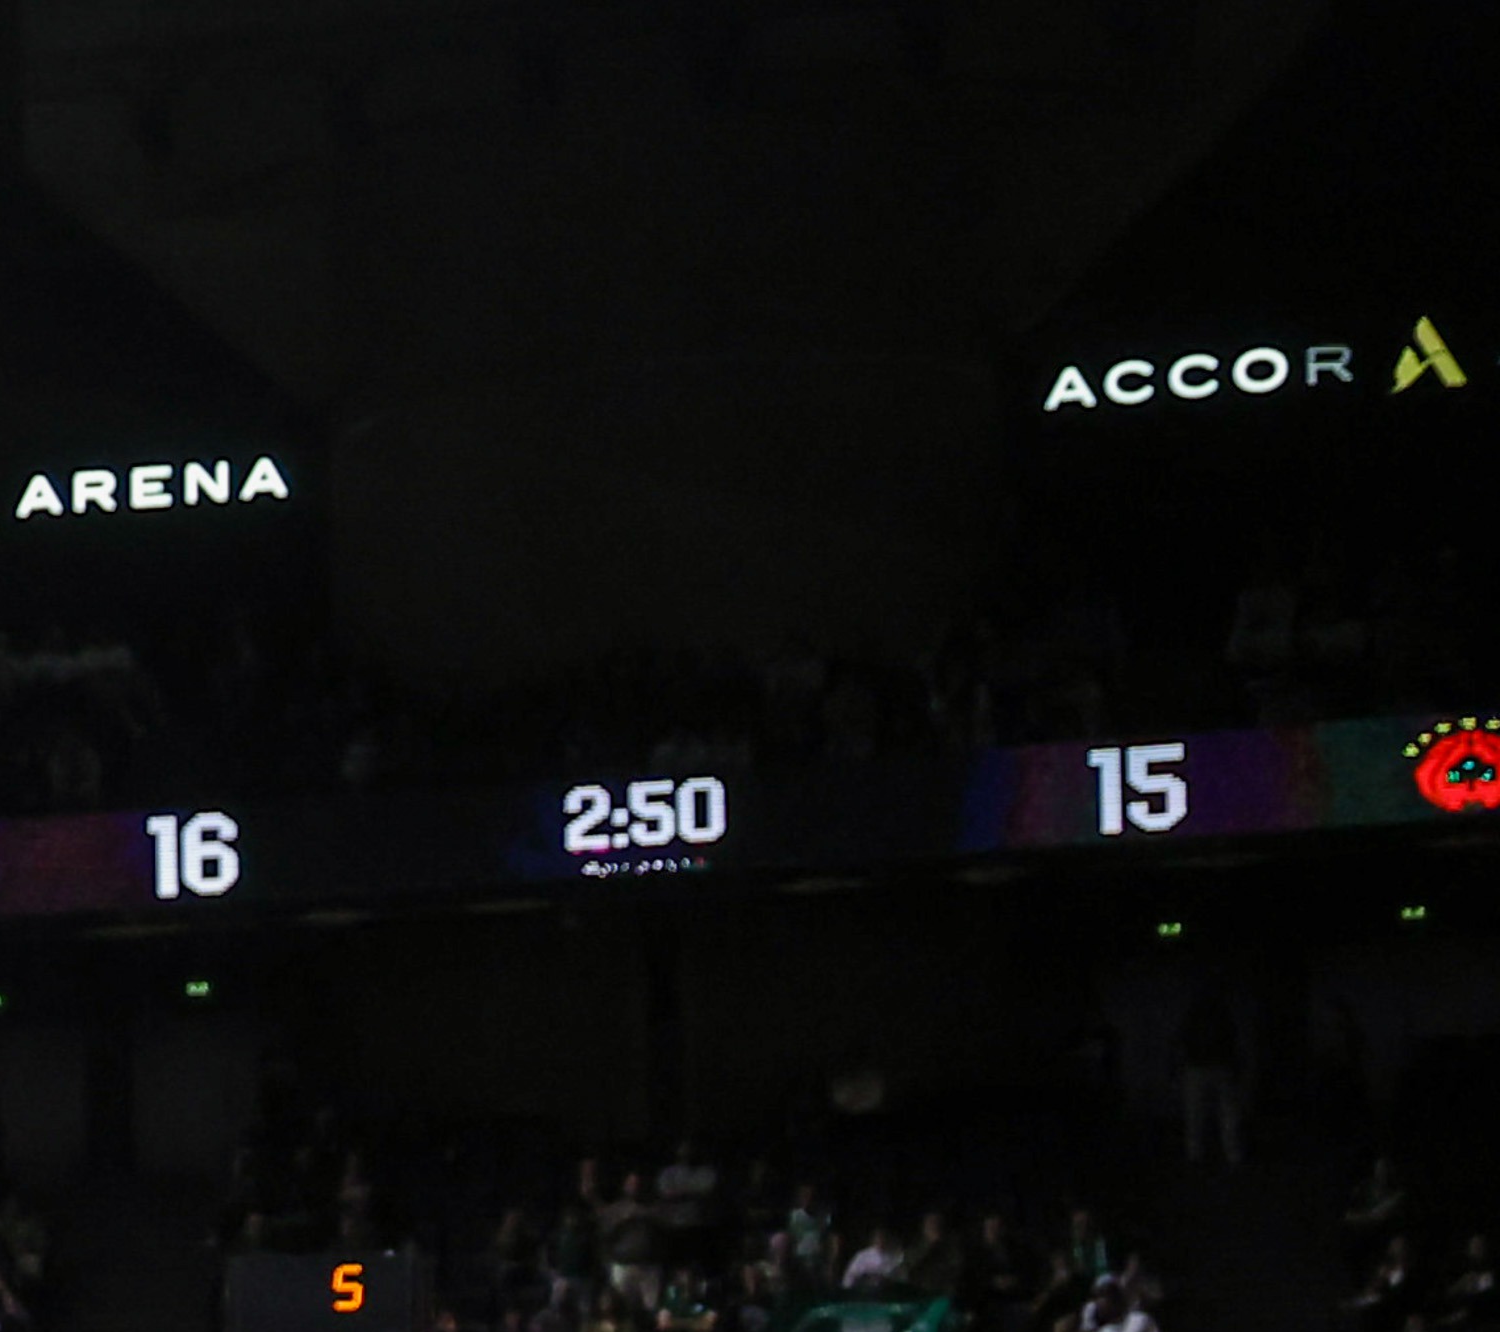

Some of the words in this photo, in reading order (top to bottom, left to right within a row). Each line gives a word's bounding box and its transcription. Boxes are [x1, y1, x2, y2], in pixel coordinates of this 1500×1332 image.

[1043, 345, 1354, 412] ACCOR
[16, 457, 289, 521] ARENA
[563, 776, 727, 852] 2:50
[1086, 742, 1189, 835] 15
[146, 810, 240, 899] 16
